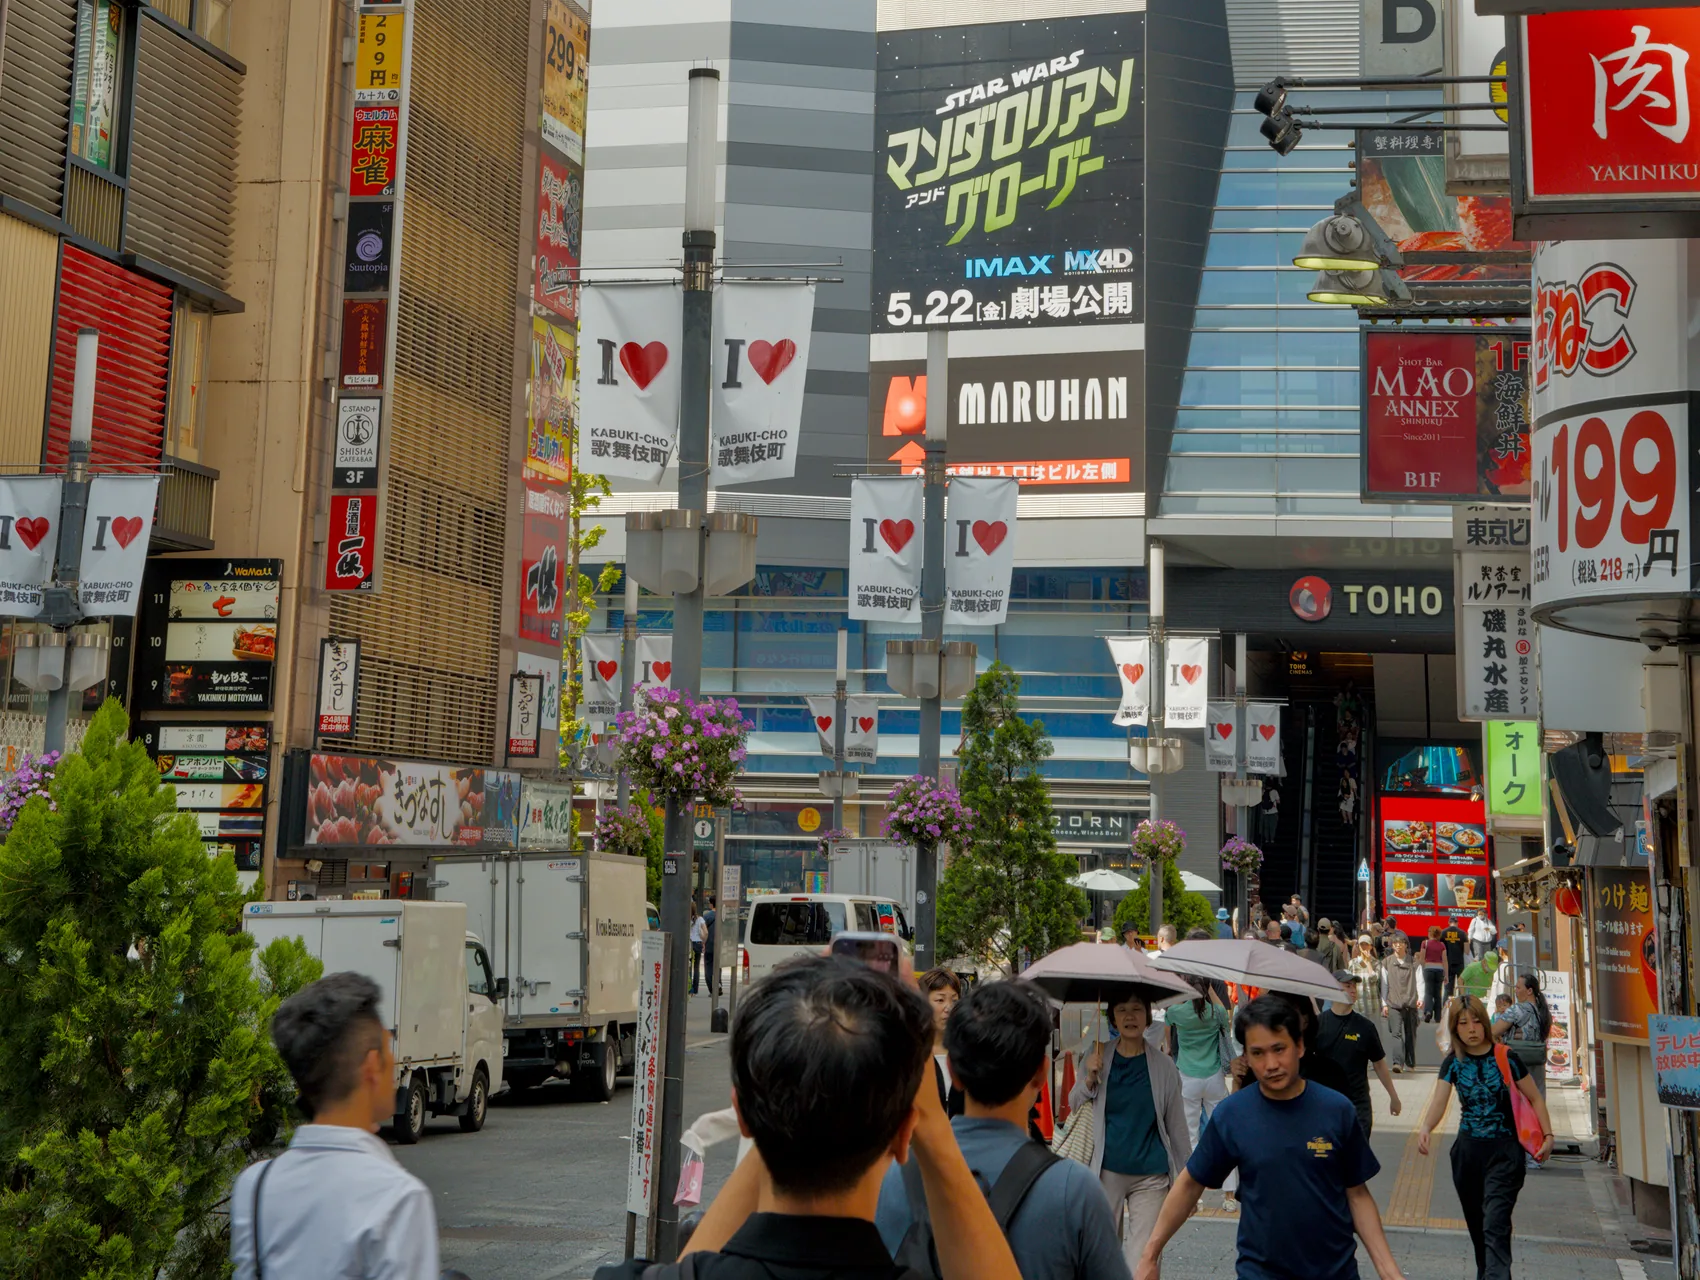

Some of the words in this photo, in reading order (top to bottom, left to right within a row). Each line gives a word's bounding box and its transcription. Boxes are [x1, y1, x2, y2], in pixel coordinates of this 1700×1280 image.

[936, 77, 1009, 116] STAR
[1011, 49, 1085, 92] WARS
[1588, 24, 1691, 144] 肉
[358, 90, 386, 101] 九十九
[355, 109, 398, 122] ウェルカム
[887, 58, 1135, 191] マンダロリアン
[353, 123, 396, 187] 麻雀
[1588, 163, 1698, 182] YAKINIKU
[382, 186, 395, 196] 6F
[905, 186, 946, 209] アンド
[944, 135, 1105, 247] グローグー
[382, 204, 394, 213] 5F
[349, 262, 389, 274] Suutopia
[965, 255, 1054, 278] IMAX
[596, 338, 619, 387] I
[722, 338, 746, 389] I
[1489, 340, 1531, 372] 1F
[1371, 365, 1475, 398] MAO
[958, 376, 1128, 425] MARUHAN
[1384, 399, 1460, 418] ANNEX
[1401, 417, 1443, 427] SHINJUKU
[1494, 372, 1527, 462] 海鮮丼
[591, 428, 669, 449] KABUKI-CHO
[719, 429, 788, 451] KABUKI-CHO
[340, 447, 373, 456] SHISHA
[590, 440, 669, 469] 歌舞伎町
[717, 442, 786, 469] 歌舞伎町
[345, 470, 365, 484] 3F
[1404, 471, 1442, 489] B1F
[345, 498, 361, 536] 居酒屋
[92, 516, 111, 551] I
[862, 517, 878, 554] I
[955, 519, 971, 558] I
[1481, 564, 1522, 582] 喫茶室
[83, 581, 134, 591] KABUKI-CHO
[360, 581, 372, 589] 2F
[857, 585, 914, 597] KABUKI-CHO
[951, 589, 1004, 599] KABUKI-CHO
[82, 590, 132, 605] 歌舞伎町
[153, 593, 164, 604] 11
[857, 594, 914, 612] 歌舞伎町
[950, 599, 1003, 613] 歌舞伎町
[1343, 584, 1443, 616] TOHO
[150, 636, 162, 647] 10
[588, 660, 598, 682] I
[1482, 608, 1509, 714] 磯丸水産
[641, 661, 651, 683] I
[1170, 663, 1180, 687] I
[151, 679, 159, 691] 9
[197, 693, 227, 703] YAKINIKU
[228, 693, 264, 703] MOTOYAMA
[322, 715, 349, 723] 24時間
[145, 733, 153, 744] 8
[1601, 881, 1650, 913] つけ麺
[1656, 1033, 1700, 1052] テレビ
[1655, 1051, 1700, 1071] 放映中
